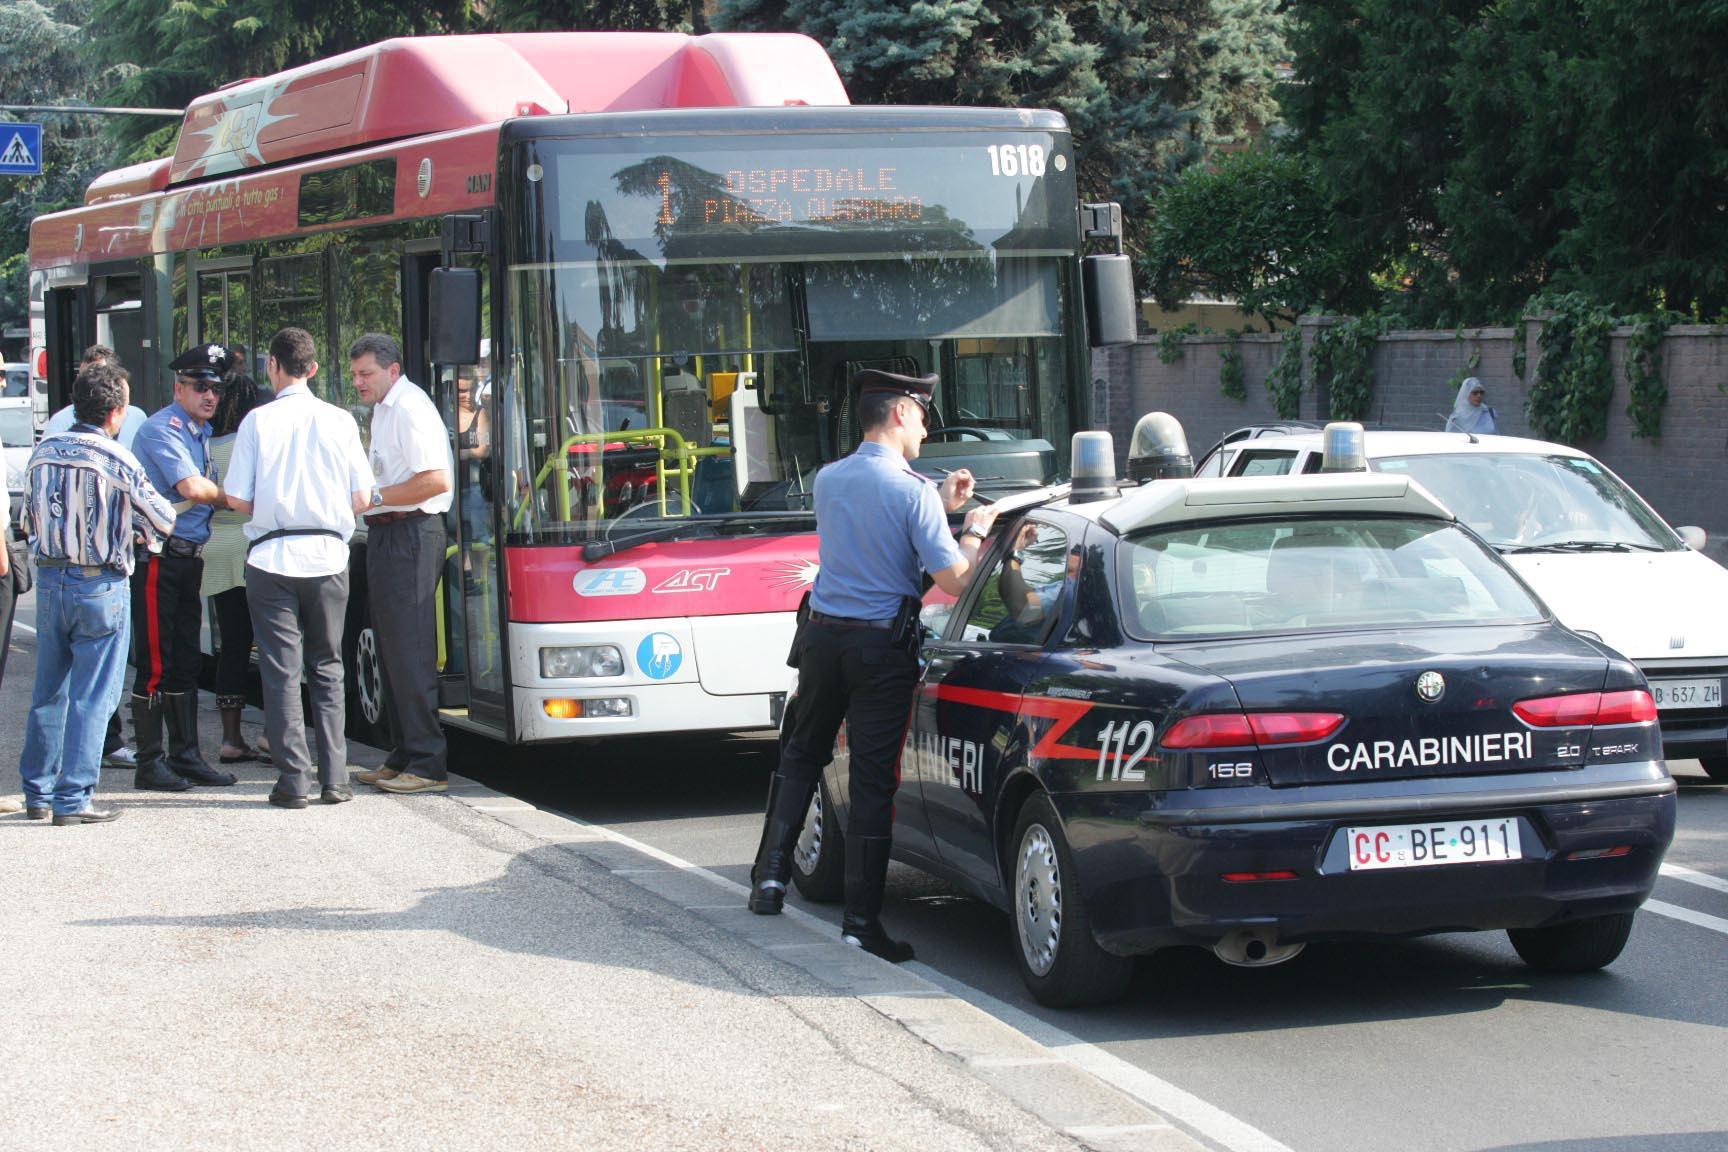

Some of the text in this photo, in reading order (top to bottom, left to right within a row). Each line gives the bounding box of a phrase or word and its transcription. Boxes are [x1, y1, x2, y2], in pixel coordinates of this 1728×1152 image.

[987, 144, 1046, 177] 1618
[467, 173, 491, 193] MAN
[726, 167, 897, 193] OSPEDALE
[658, 169, 676, 225] 1
[704, 197, 792, 223] PIAZZA
[651, 567, 731, 594] ACT
[1650, 685, 1720, 704] B 637 ZH
[1096, 720, 1155, 783] 112
[1326, 731, 1533, 772] CARABINIERI
[1208, 762, 1253, 779] 156
[1354, 823, 1511, 865] CC BE 911
